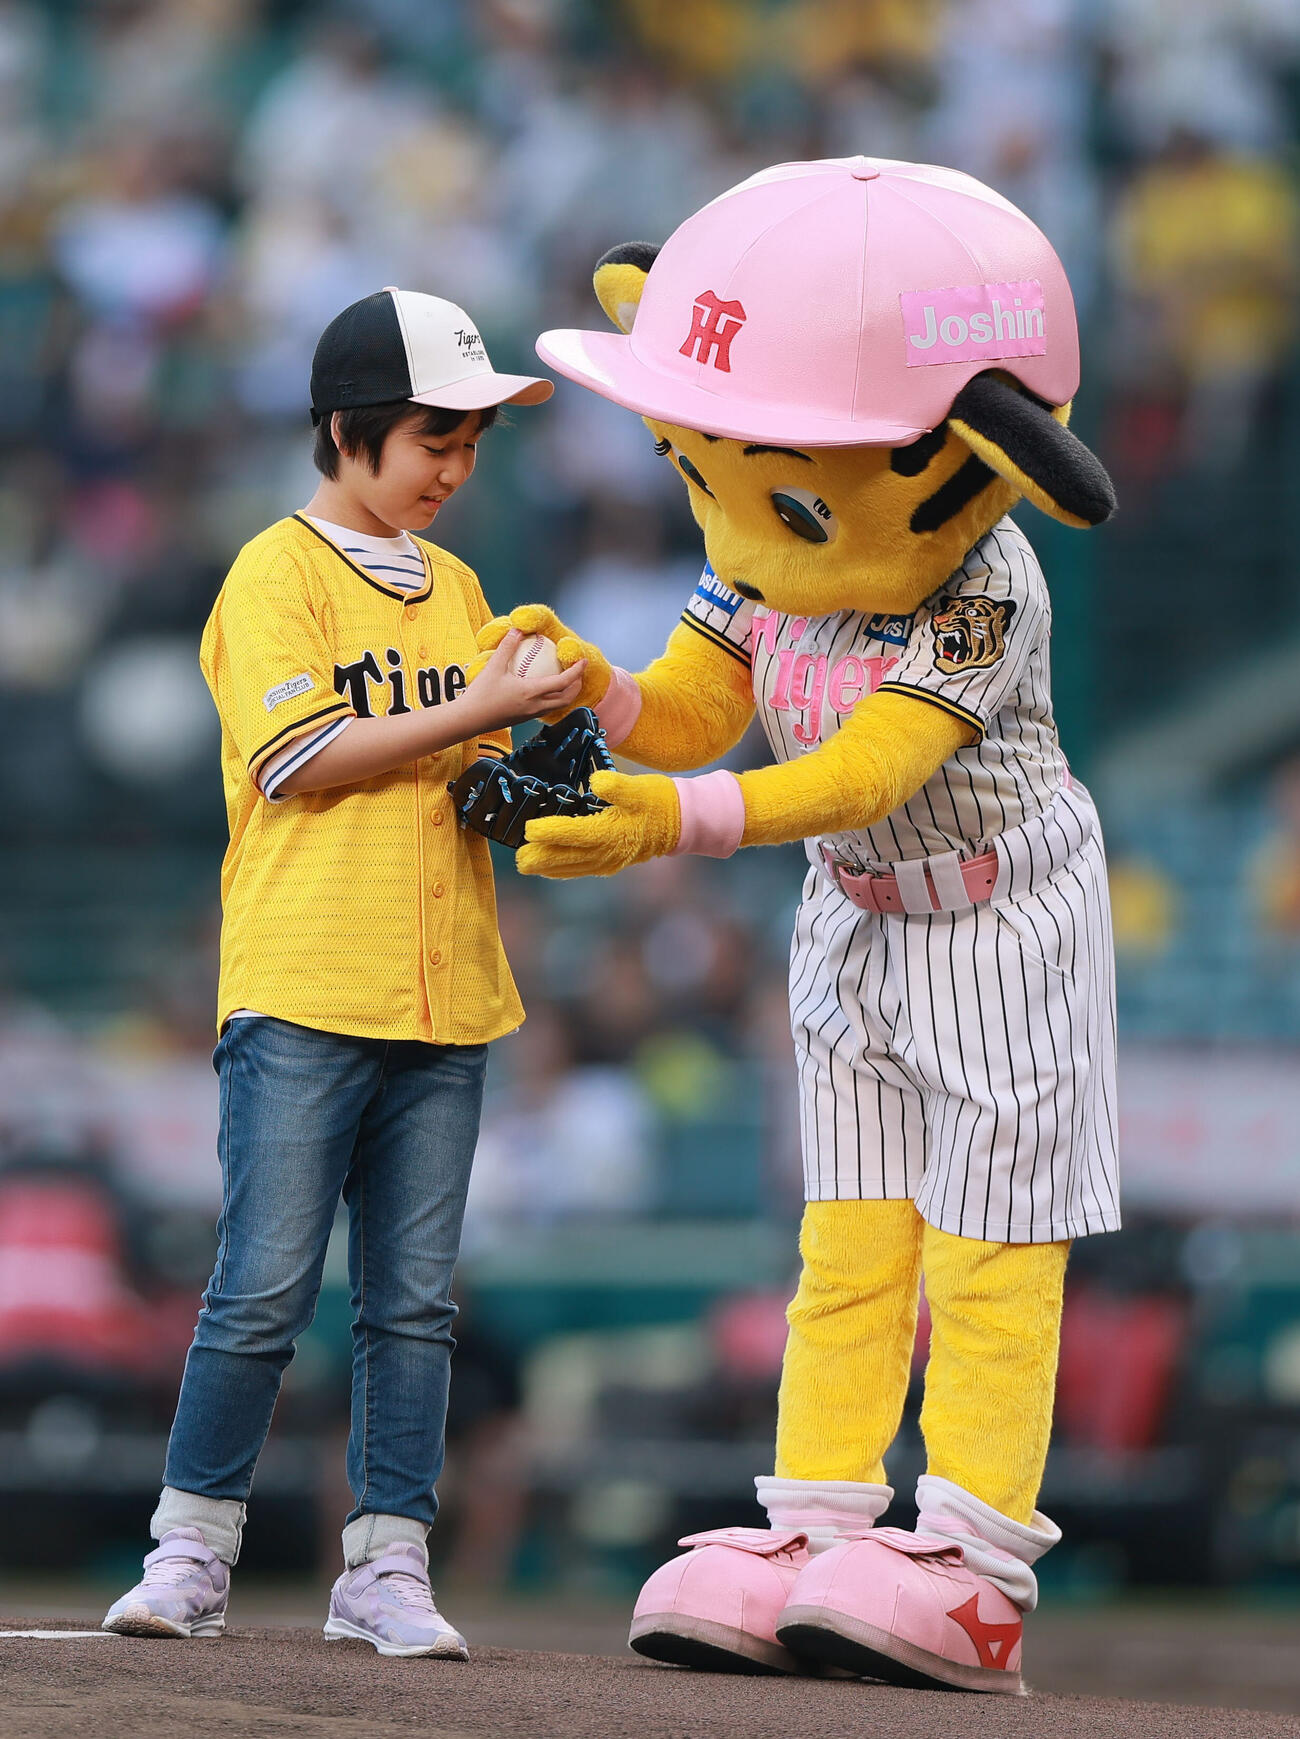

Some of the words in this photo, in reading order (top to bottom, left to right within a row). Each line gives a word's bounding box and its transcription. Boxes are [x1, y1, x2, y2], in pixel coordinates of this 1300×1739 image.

[454, 329, 481, 350] Tigers
[909, 298, 1044, 349] Joshin
[698, 571, 742, 607] oshin
[870, 615, 911, 639] Jos
[333, 647, 470, 718] Tige
[752, 609, 900, 745] Tiger
